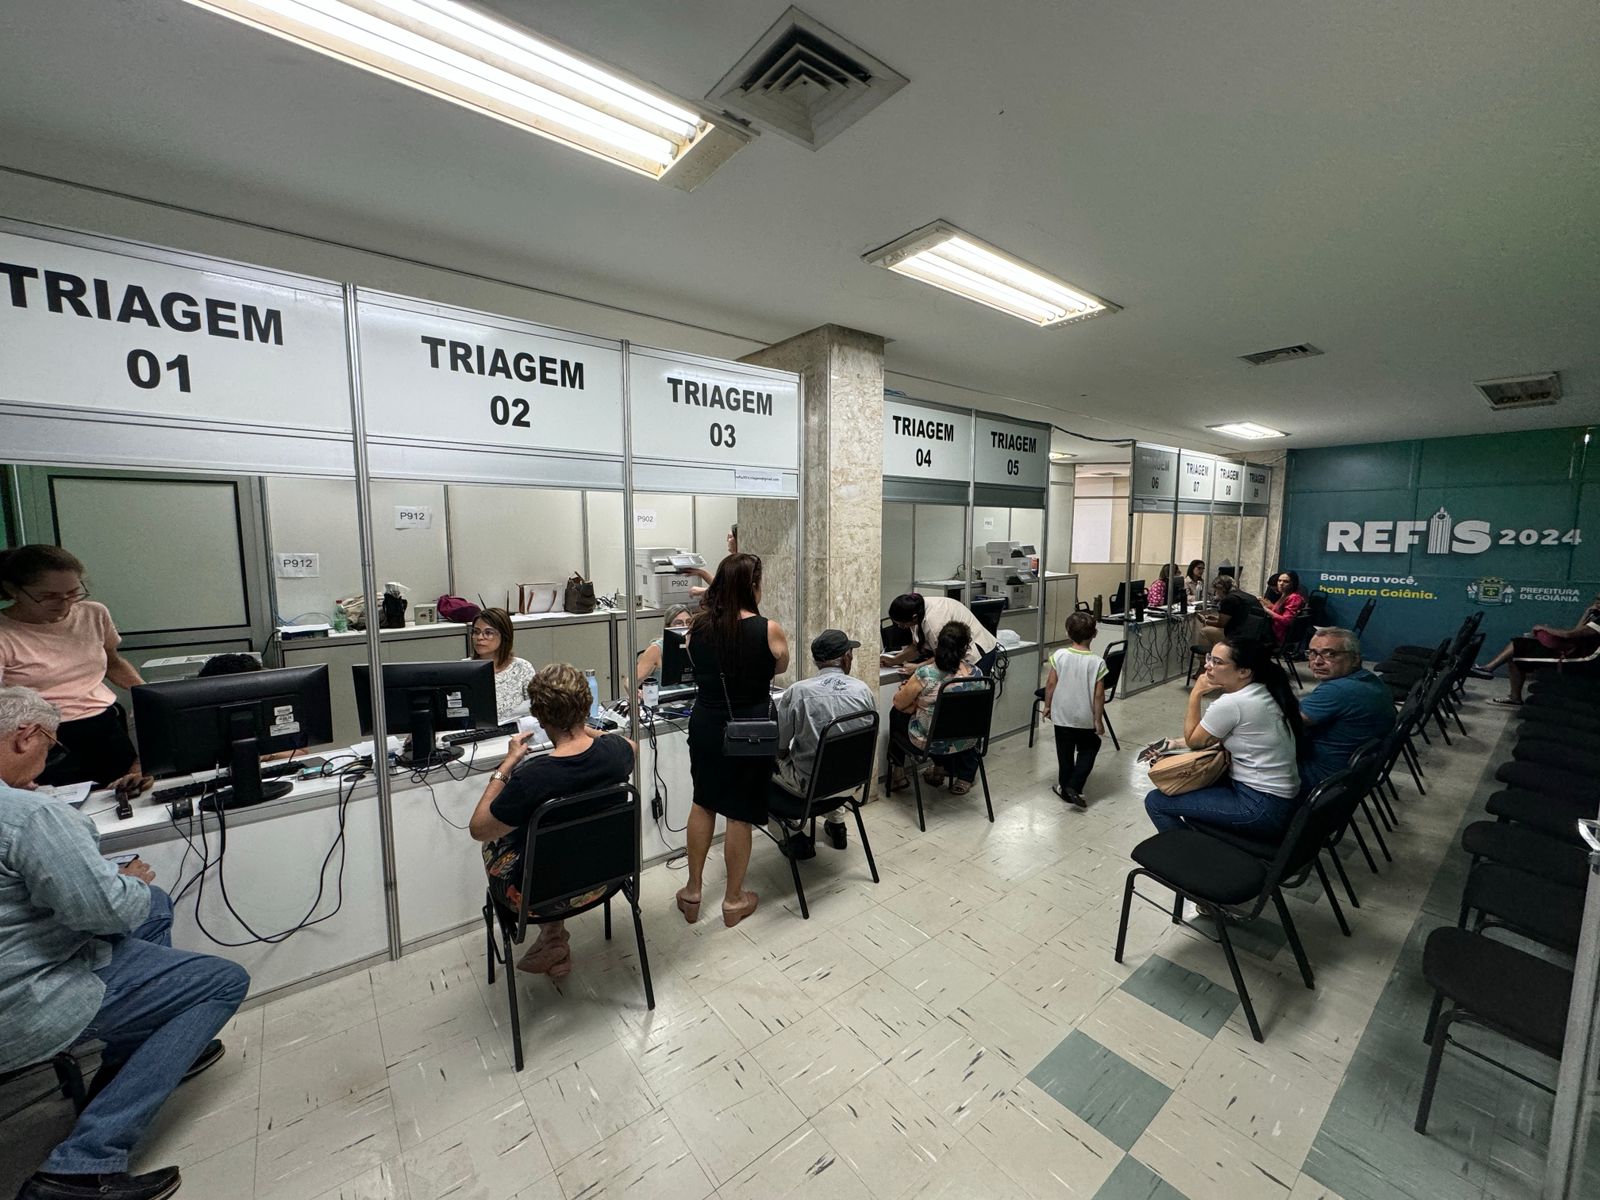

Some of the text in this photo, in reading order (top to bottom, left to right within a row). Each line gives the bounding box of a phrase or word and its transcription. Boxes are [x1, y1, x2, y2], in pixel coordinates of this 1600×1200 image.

[0, 262, 284, 346] TRIAGEM
[126, 348, 191, 393] 01
[421, 335, 584, 390] TRIAGEM
[667, 377, 773, 416] TRIAGEM
[490, 395, 531, 428] 02
[709, 422, 736, 448] 03
[892, 415, 954, 442] TRIAGEM
[991, 431, 1037, 453] TRIAGEM
[915, 448, 932, 467] 04
[1142, 455, 1170, 472] AGEM
[1007, 459, 1019, 476] 05
[1186, 462, 1209, 476] TRIAGEM
[1220, 468, 1239, 480] TRIAGEM
[1151, 476, 1159, 489] 06
[1249, 472, 1265, 484] TRIAGEM
[400, 512, 425, 520] P912
[637, 515, 654, 523] P902
[1326, 507, 1581, 555] REFIS 2024
[283, 559, 313, 568] P912
[1320, 573, 1418, 586] Bom para você,
[1348, 588, 1377, 596] para
[1380, 588, 1437, 600] Goiânia.
[1520, 586, 1580, 596] PREFEITURA
[1534, 594, 1580, 602] GOIÂNIA
